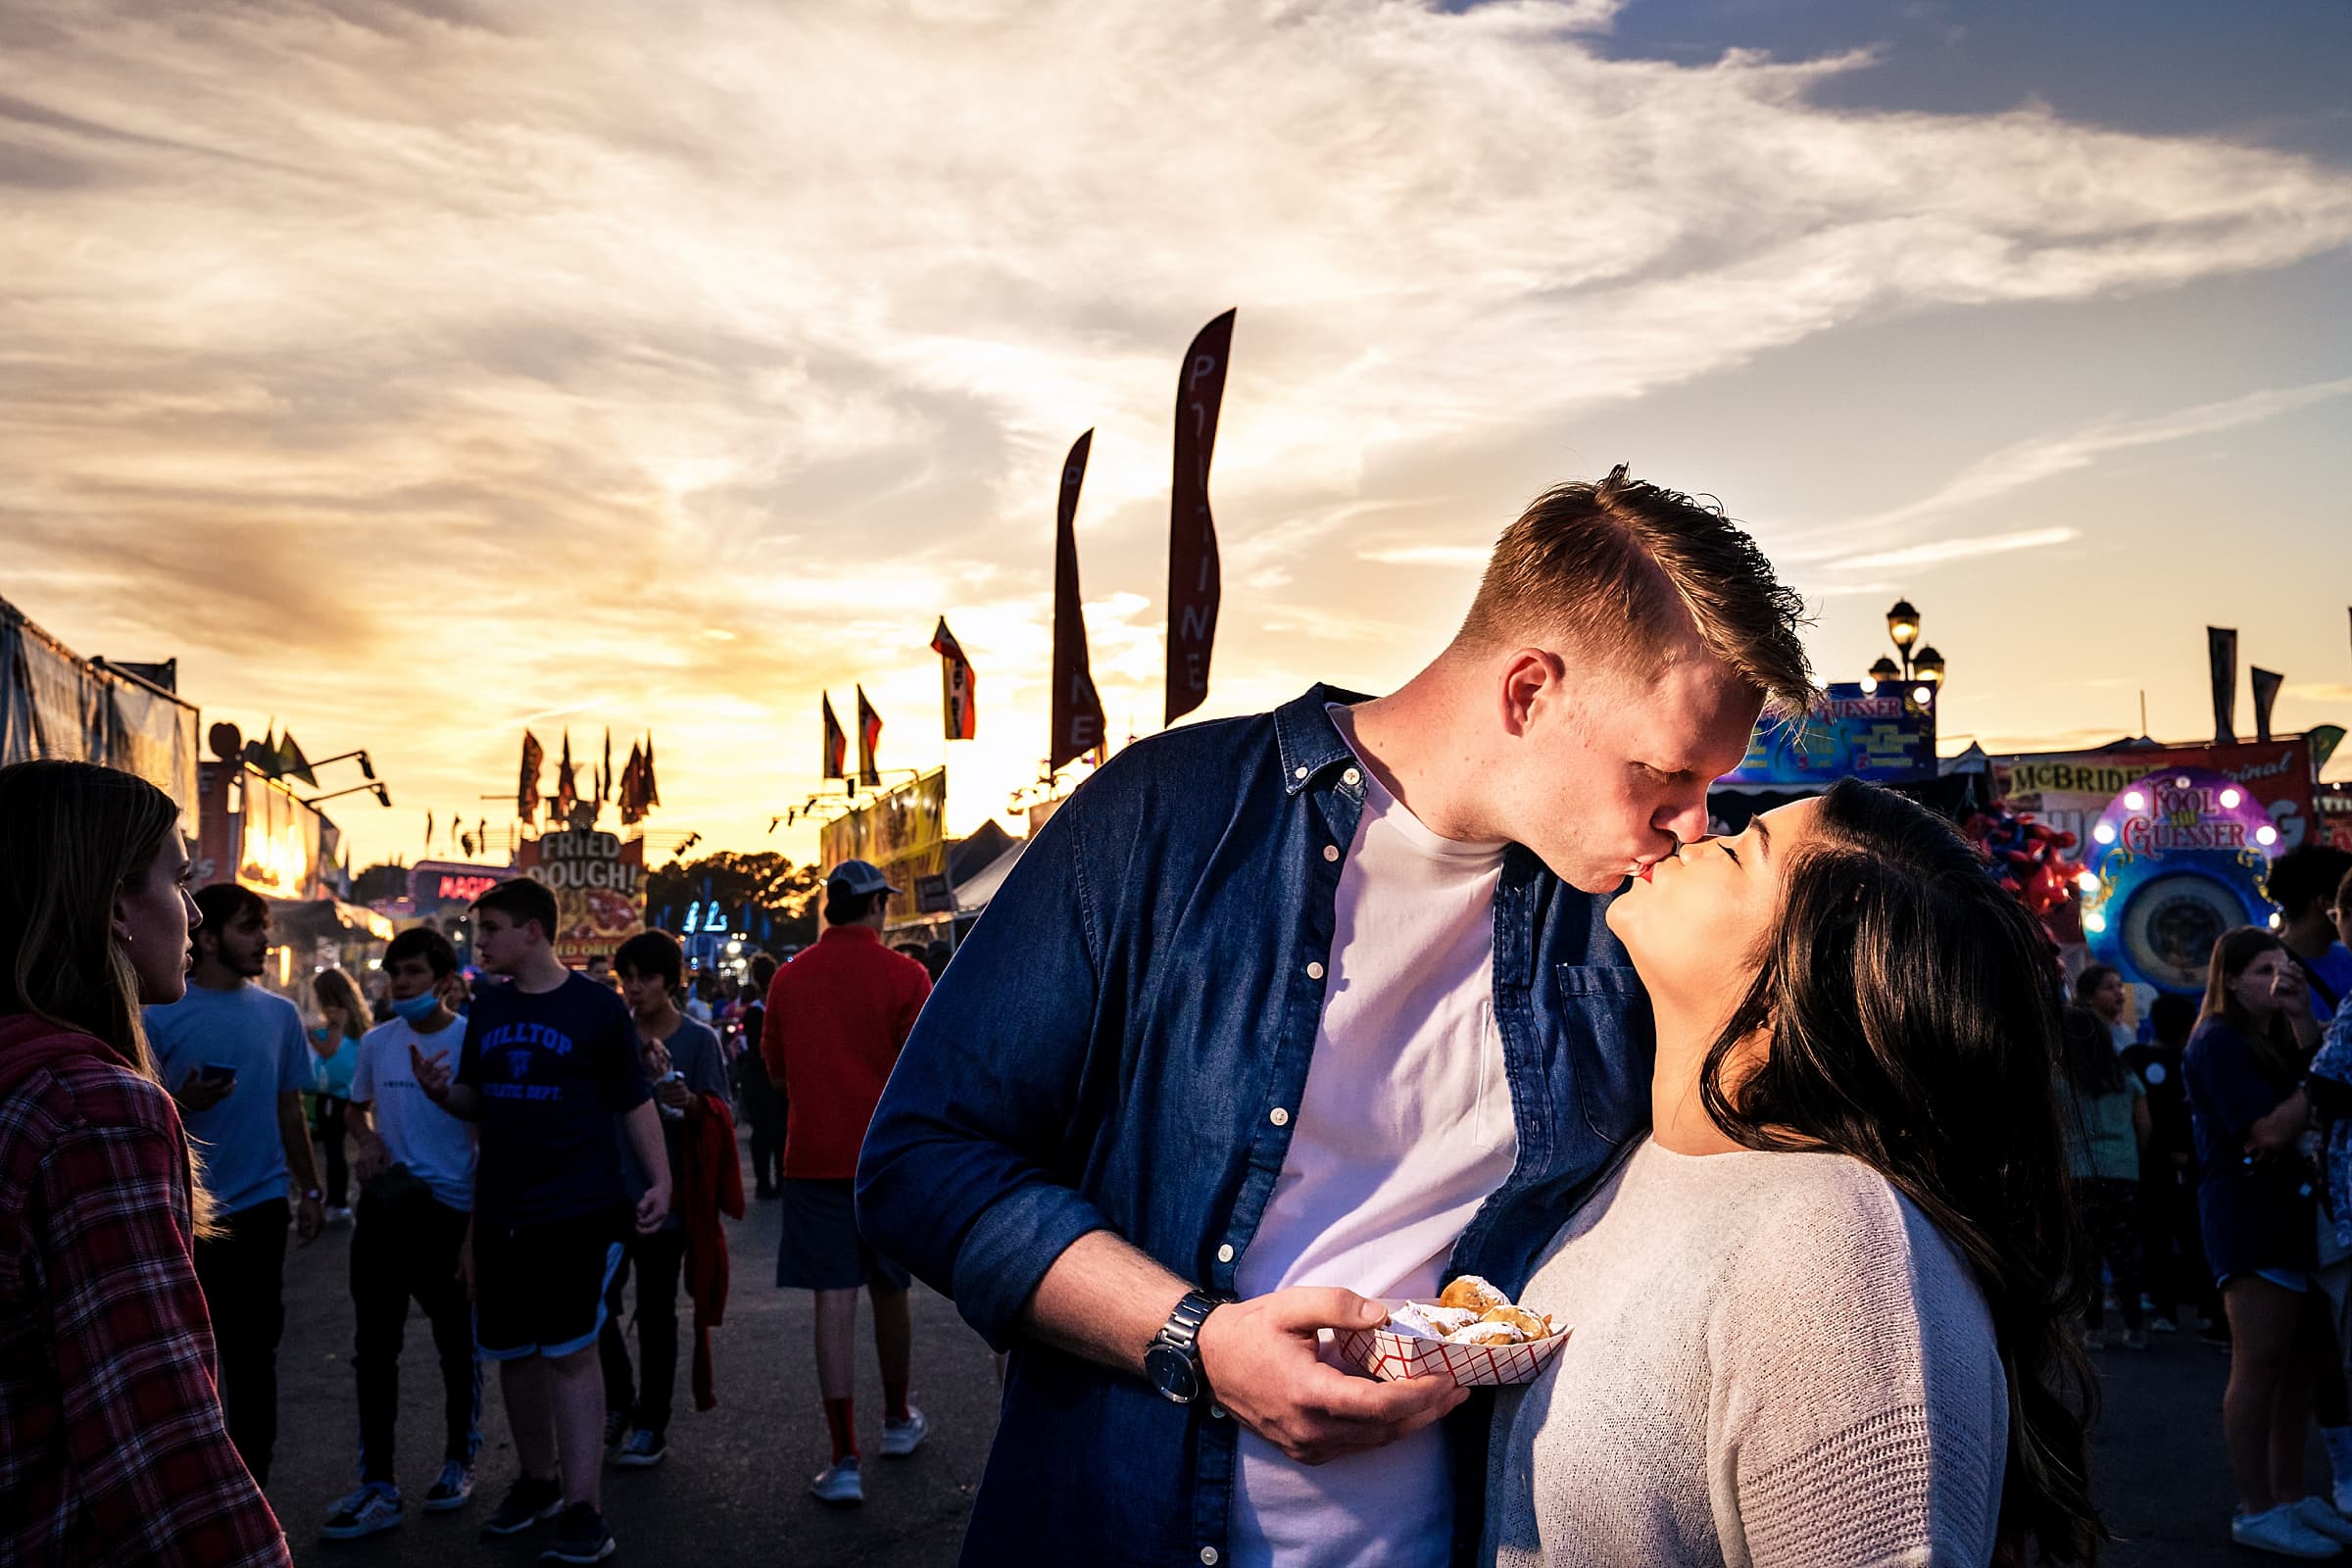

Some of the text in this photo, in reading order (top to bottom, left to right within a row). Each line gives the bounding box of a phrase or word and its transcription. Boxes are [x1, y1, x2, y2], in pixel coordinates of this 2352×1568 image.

[2143, 775, 2219, 820] FOOL
[541, 832, 621, 859] FRIED
[2122, 815, 2246, 859] GUESSER
[525, 860, 637, 894] DOUGH!
[479, 1022, 573, 1058] HILLTOP
